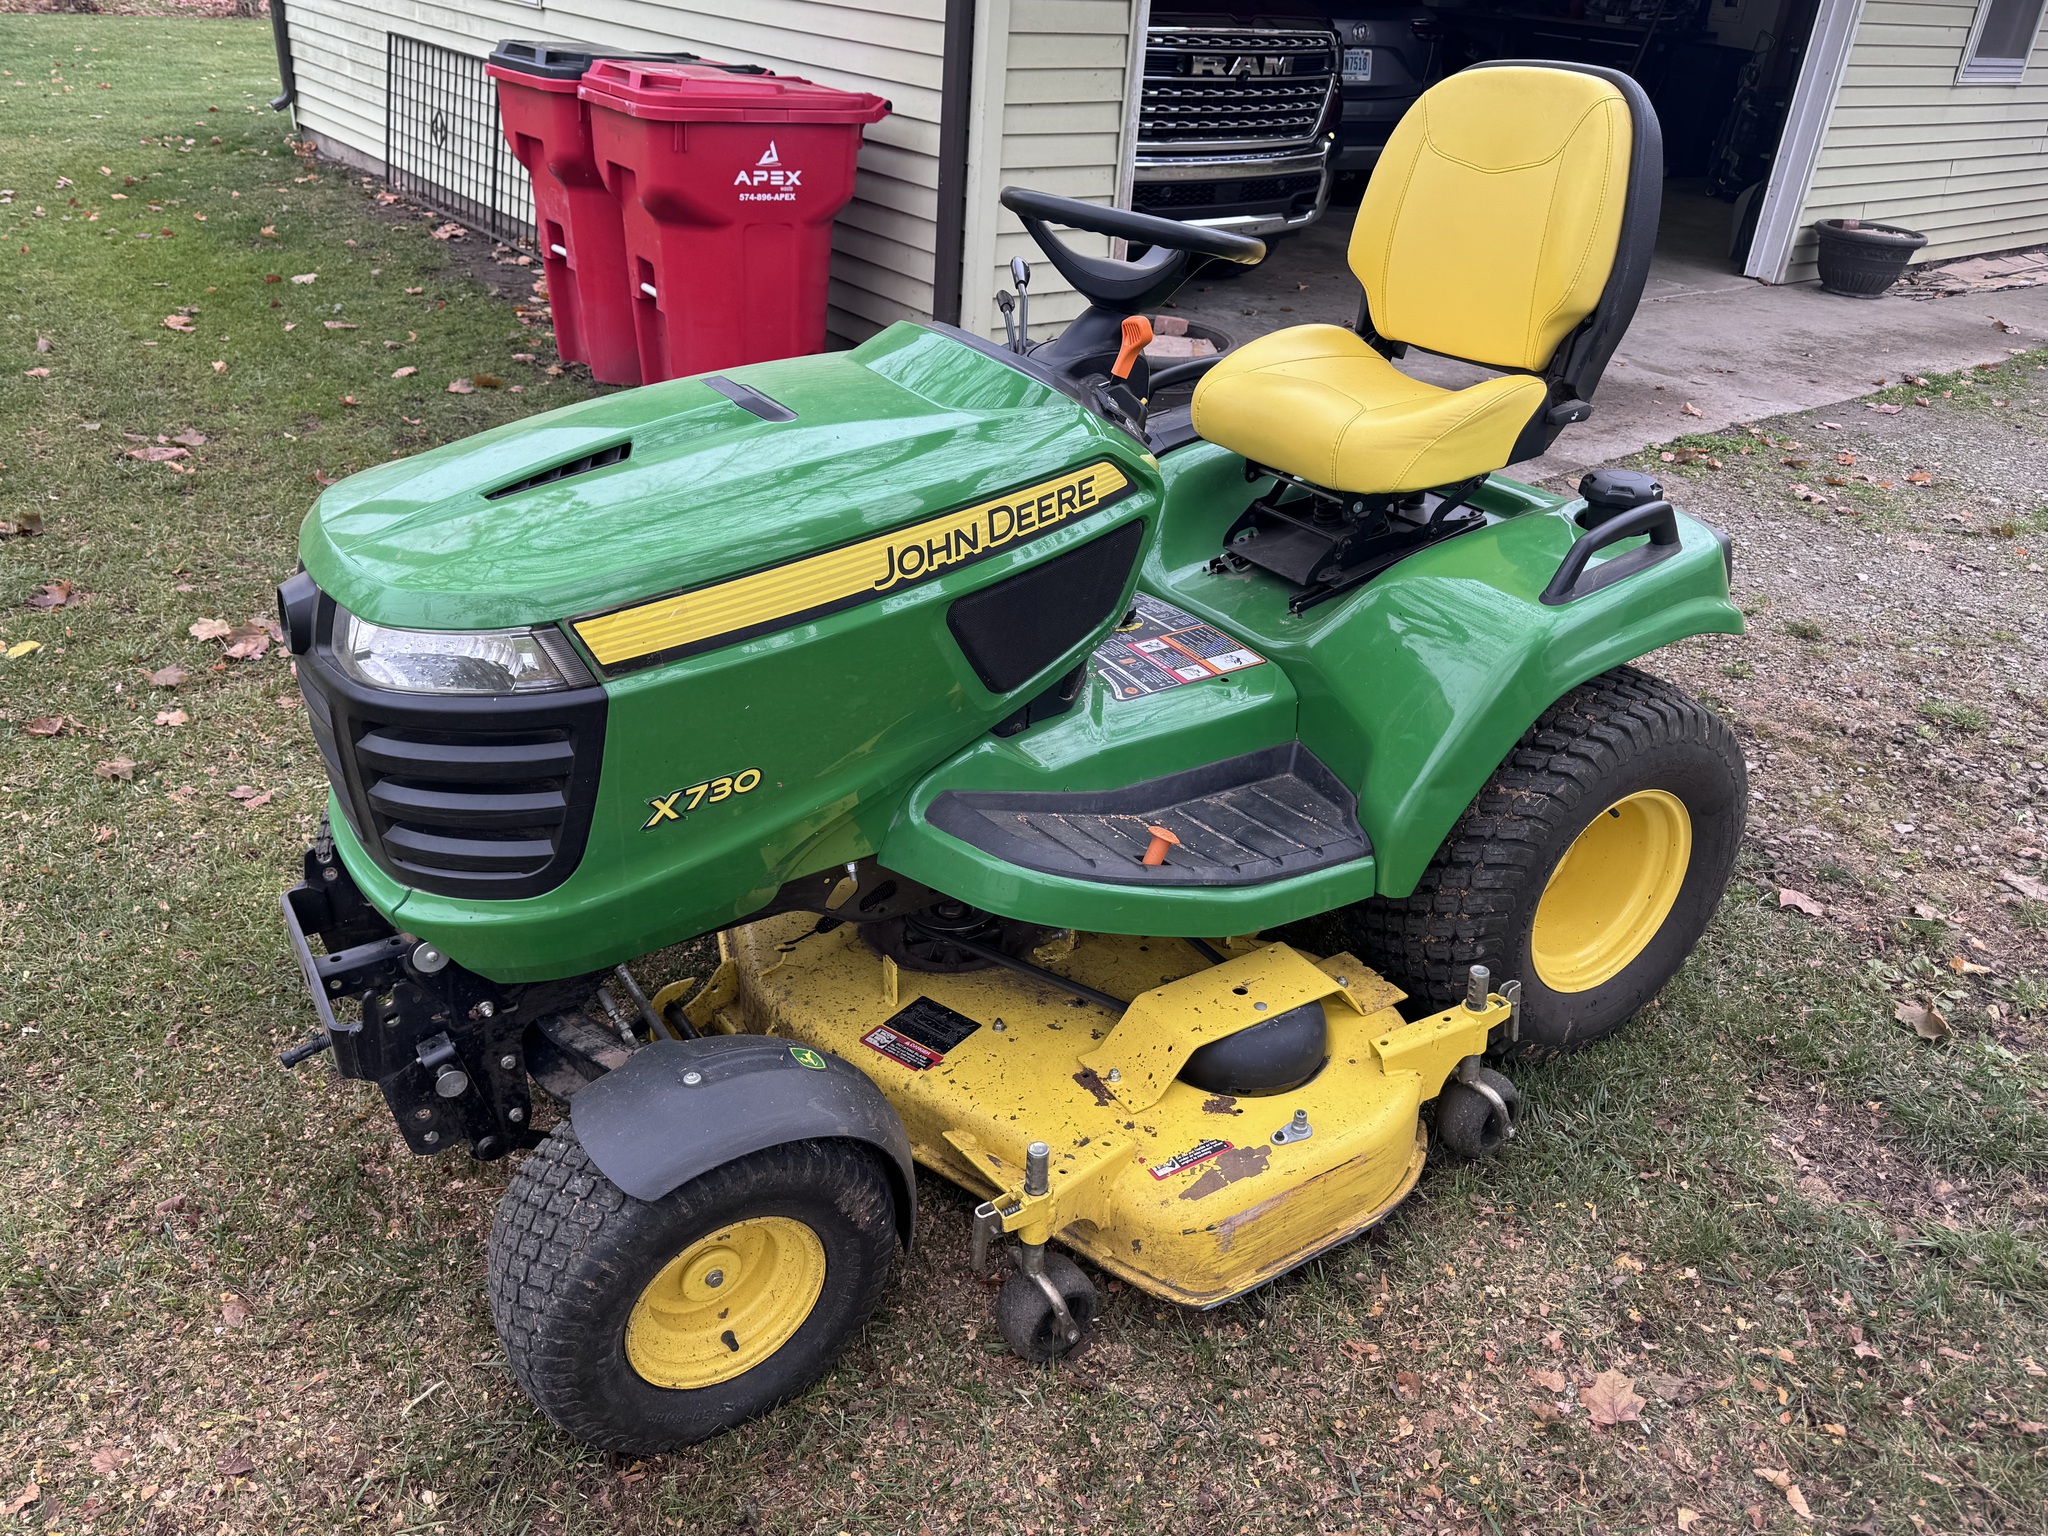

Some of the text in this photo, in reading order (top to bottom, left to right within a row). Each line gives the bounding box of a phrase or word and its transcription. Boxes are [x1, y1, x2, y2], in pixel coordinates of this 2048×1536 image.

[1191, 55, 1294, 75] RAM
[733, 170, 802, 186] APEX
[739, 193, 796, 201] 574-896-APEX
[873, 474, 1099, 588] JOHN DEERE
[644, 766, 763, 829] X730
[909, 1042, 932, 1056] DANGER
